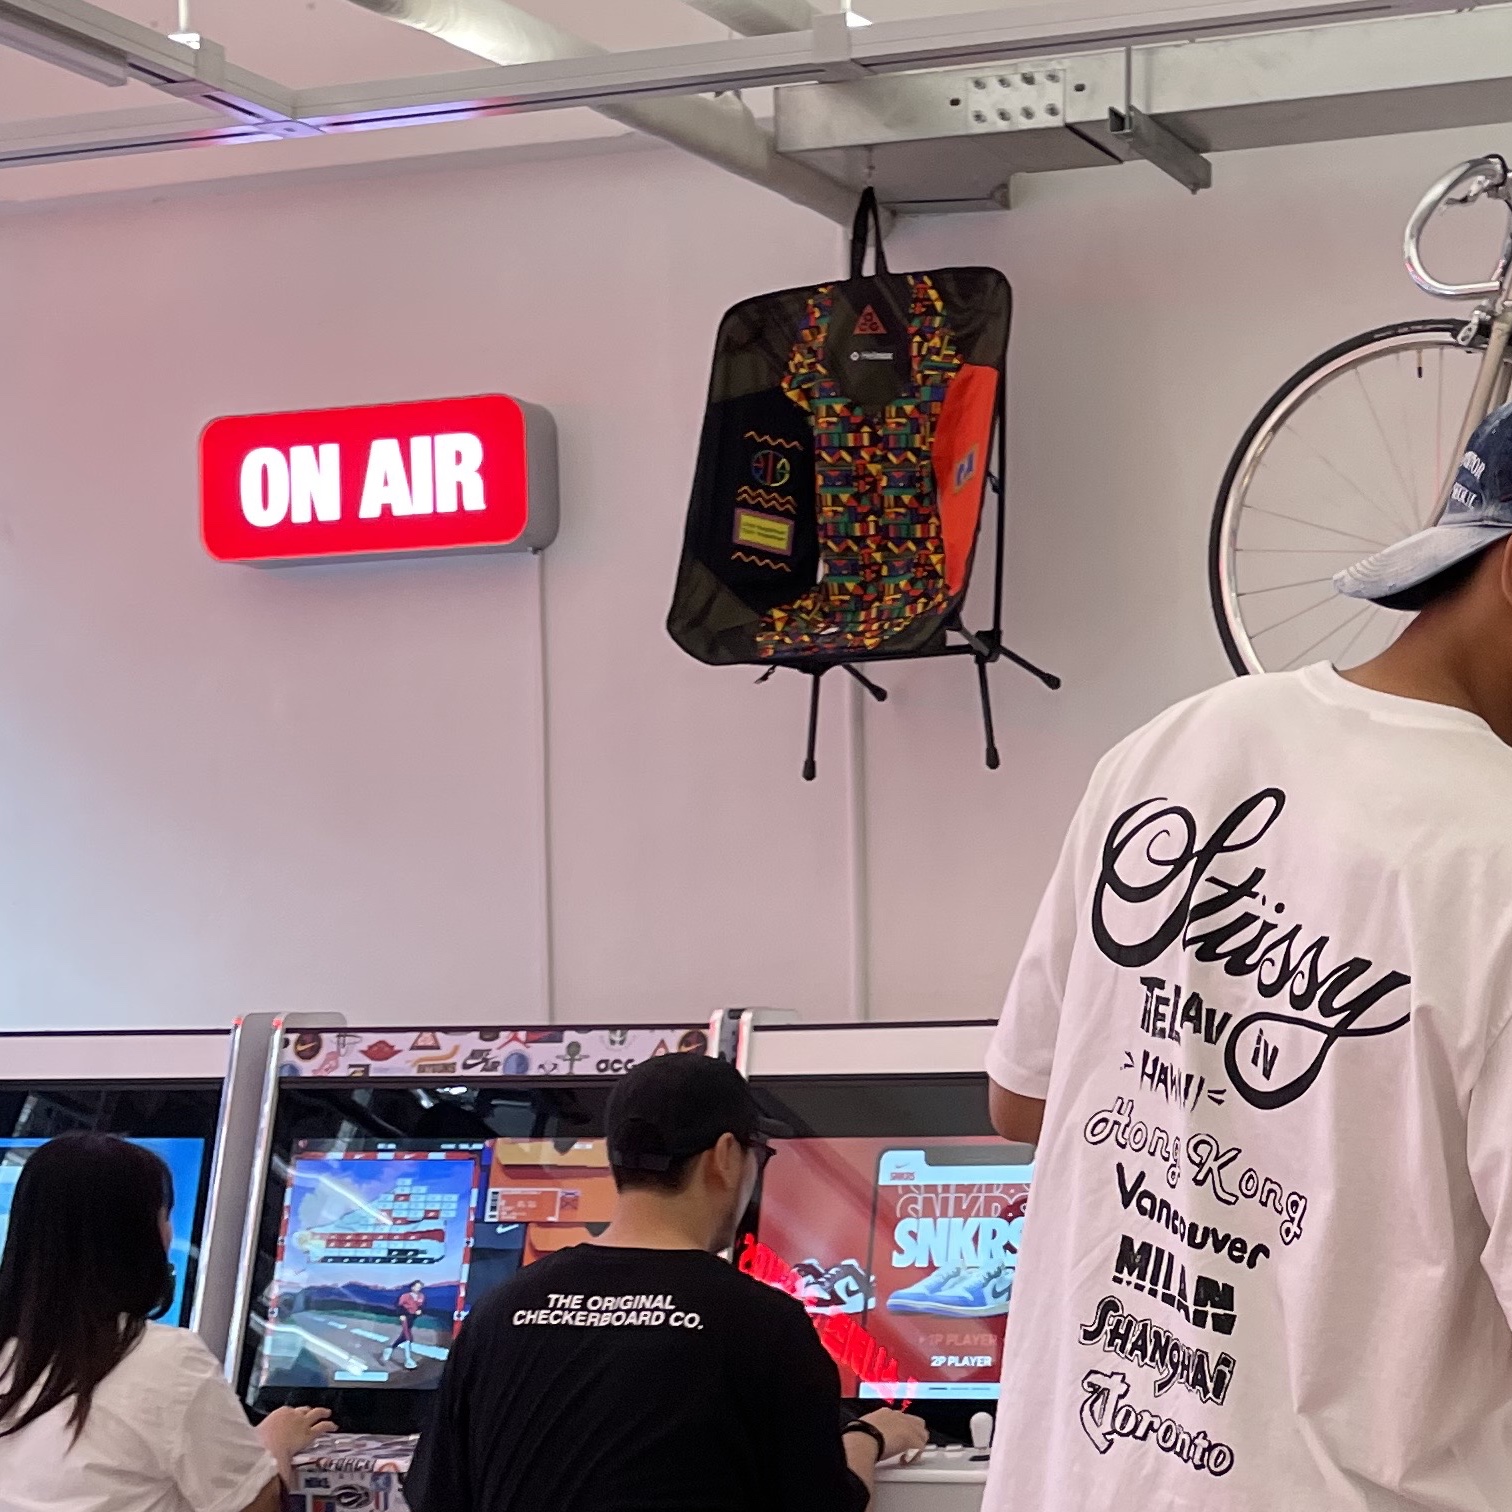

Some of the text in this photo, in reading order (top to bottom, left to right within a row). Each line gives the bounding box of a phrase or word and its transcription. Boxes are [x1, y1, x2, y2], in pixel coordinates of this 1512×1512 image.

[240, 432, 486, 527] ON AIR
[1083, 1096, 1308, 1246] Hong Kong
[512, 1310, 704, 1330] CHECKERBOARD CO.
[547, 1293, 677, 1312] THE ORIGINAL
[931, 1355, 992, 1367] 2P PLAYER
[1079, 1369, 1235, 1478] Toronto
